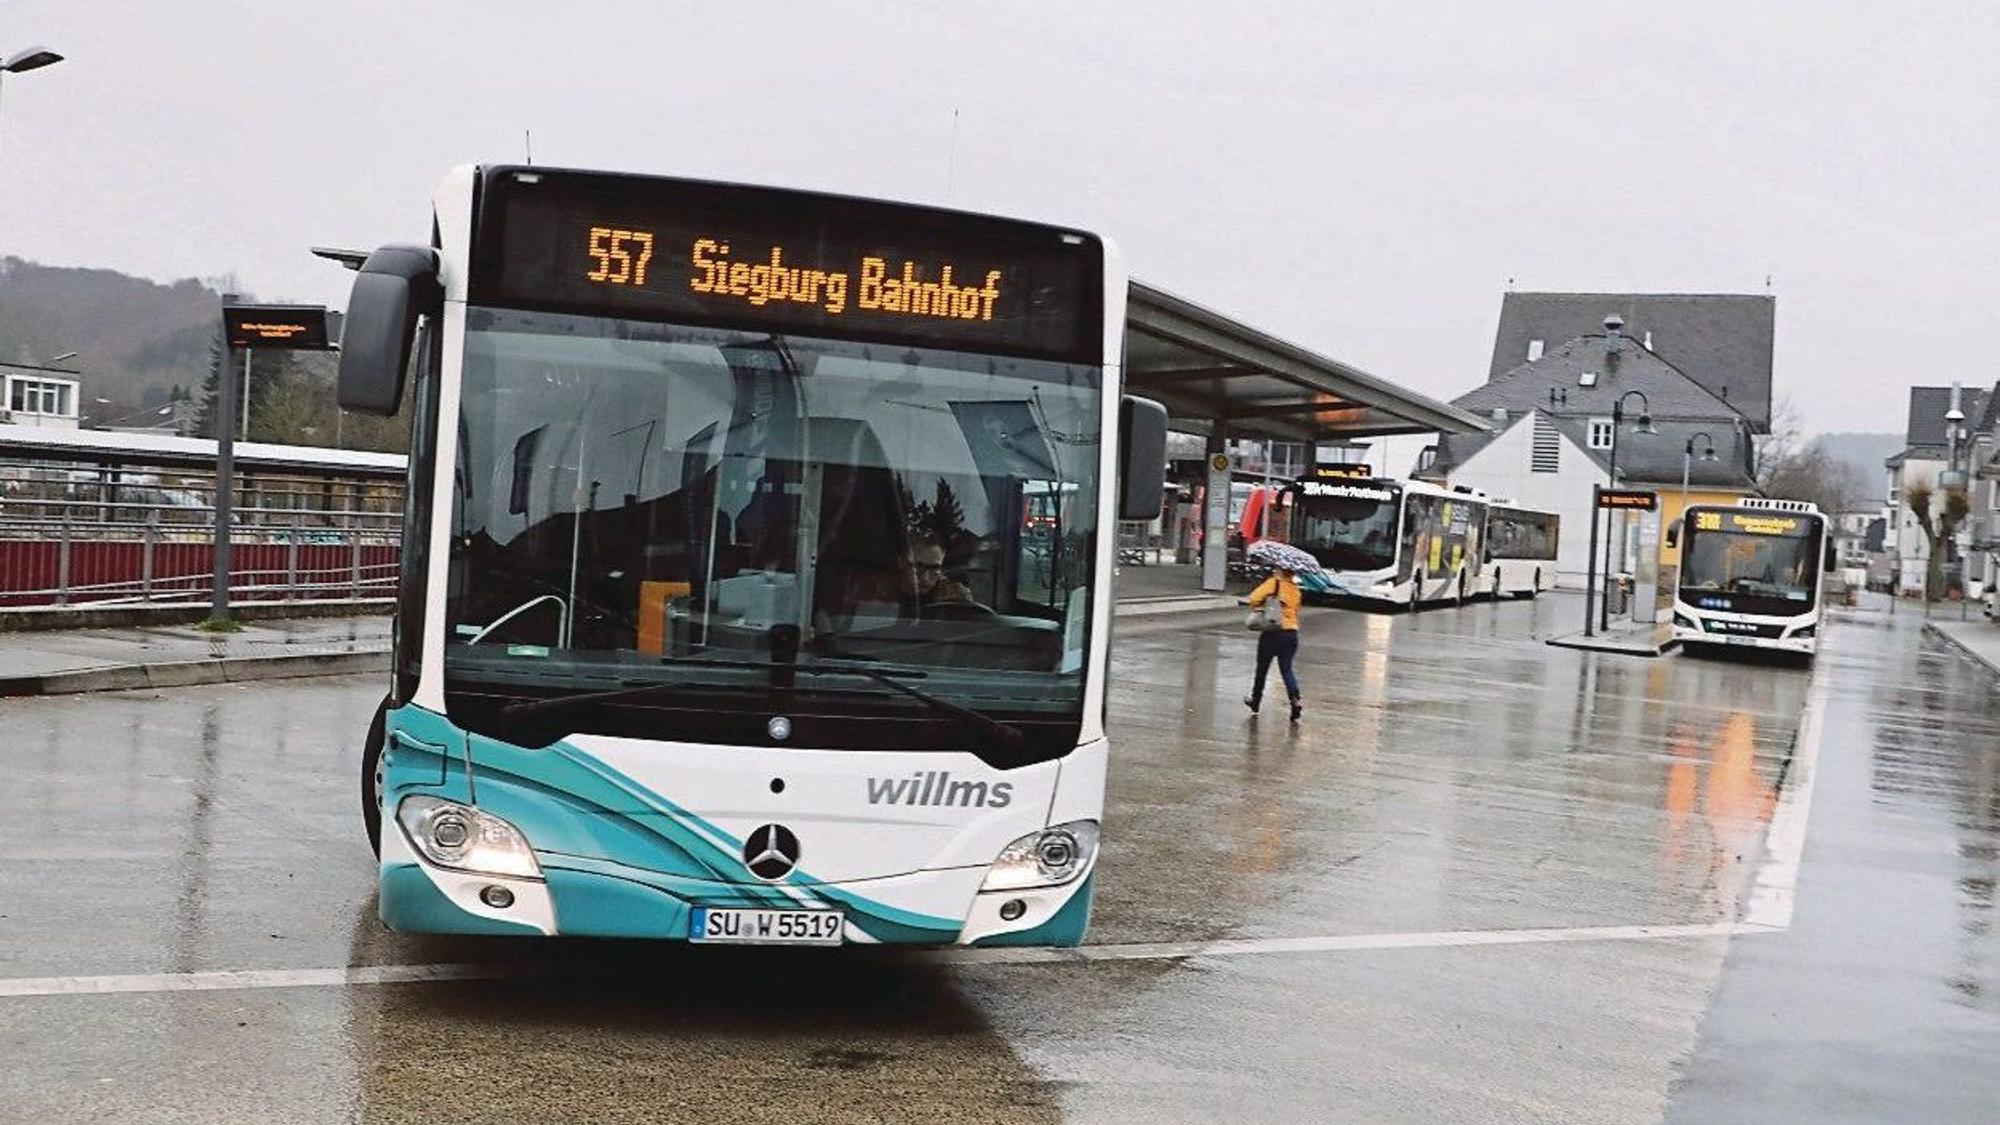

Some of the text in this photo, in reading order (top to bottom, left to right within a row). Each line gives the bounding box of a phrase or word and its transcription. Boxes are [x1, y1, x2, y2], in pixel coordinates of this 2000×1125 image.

[587, 226, 1001, 320] 557 Siegburg Bahnhof
[867, 771, 1013, 808] willms
[707, 912, 839, 938] SU W 5519
